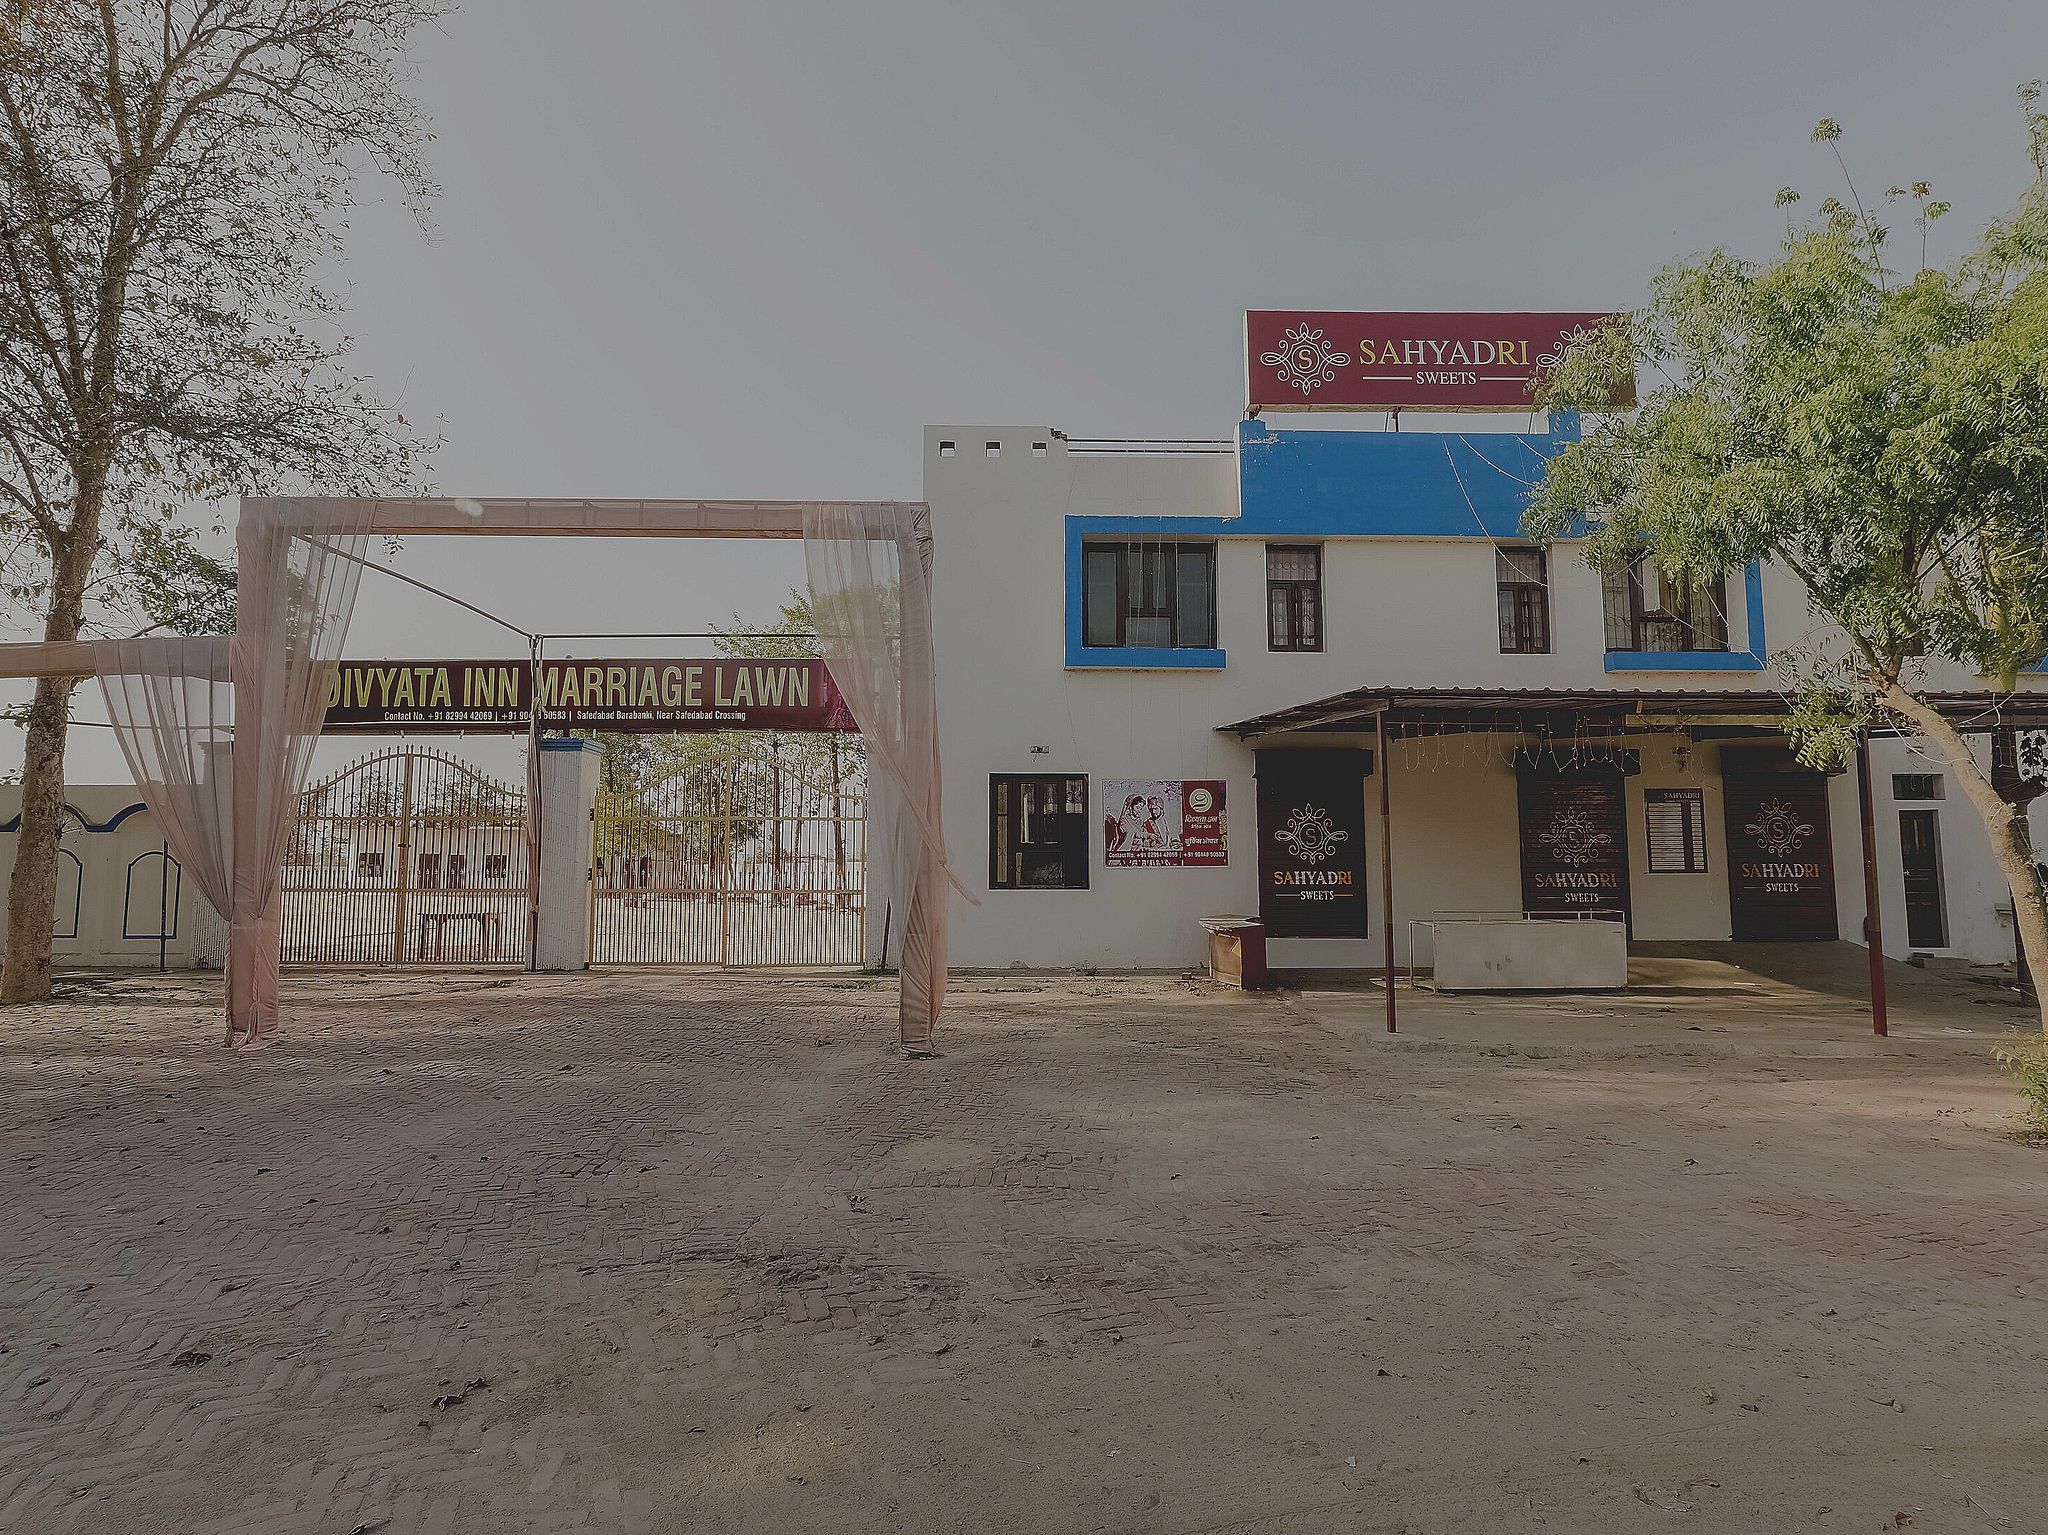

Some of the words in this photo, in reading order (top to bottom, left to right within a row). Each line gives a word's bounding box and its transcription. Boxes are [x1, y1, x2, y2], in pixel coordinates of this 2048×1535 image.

[1359, 339, 1530, 366] SAHYADRI
[1416, 371, 1477, 385] SWEETS
[321, 667, 452, 708] DIVYATA
[463, 667, 519, 707] INN
[536, 666, 703, 707] MARRIAGE
[714, 666, 809, 707] LAWN
[384, 711, 411, 720] Contact
[413, 711, 425, 720] No.
[428, 711, 442, 720] +91
[445, 711, 468, 720] 82994
[501, 711, 517, 720] +91
[576, 711, 615, 720] Safedabad
[616, 711, 655, 721] Barabanki,
[656, 711, 674, 720] Near
[675, 711, 713, 720] Safedabad
[714, 711, 746, 721] Crossing
[1741, 863, 1820, 878] SAHYADRI
[1274, 871, 1353, 885] SAHYADRI
[1535, 873, 1618, 888] SAHYADRI
[1765, 882, 1800, 892] SWEETS
[1300, 891, 1335, 901] SWEETS
[1564, 892, 1599, 903] SWEETS
